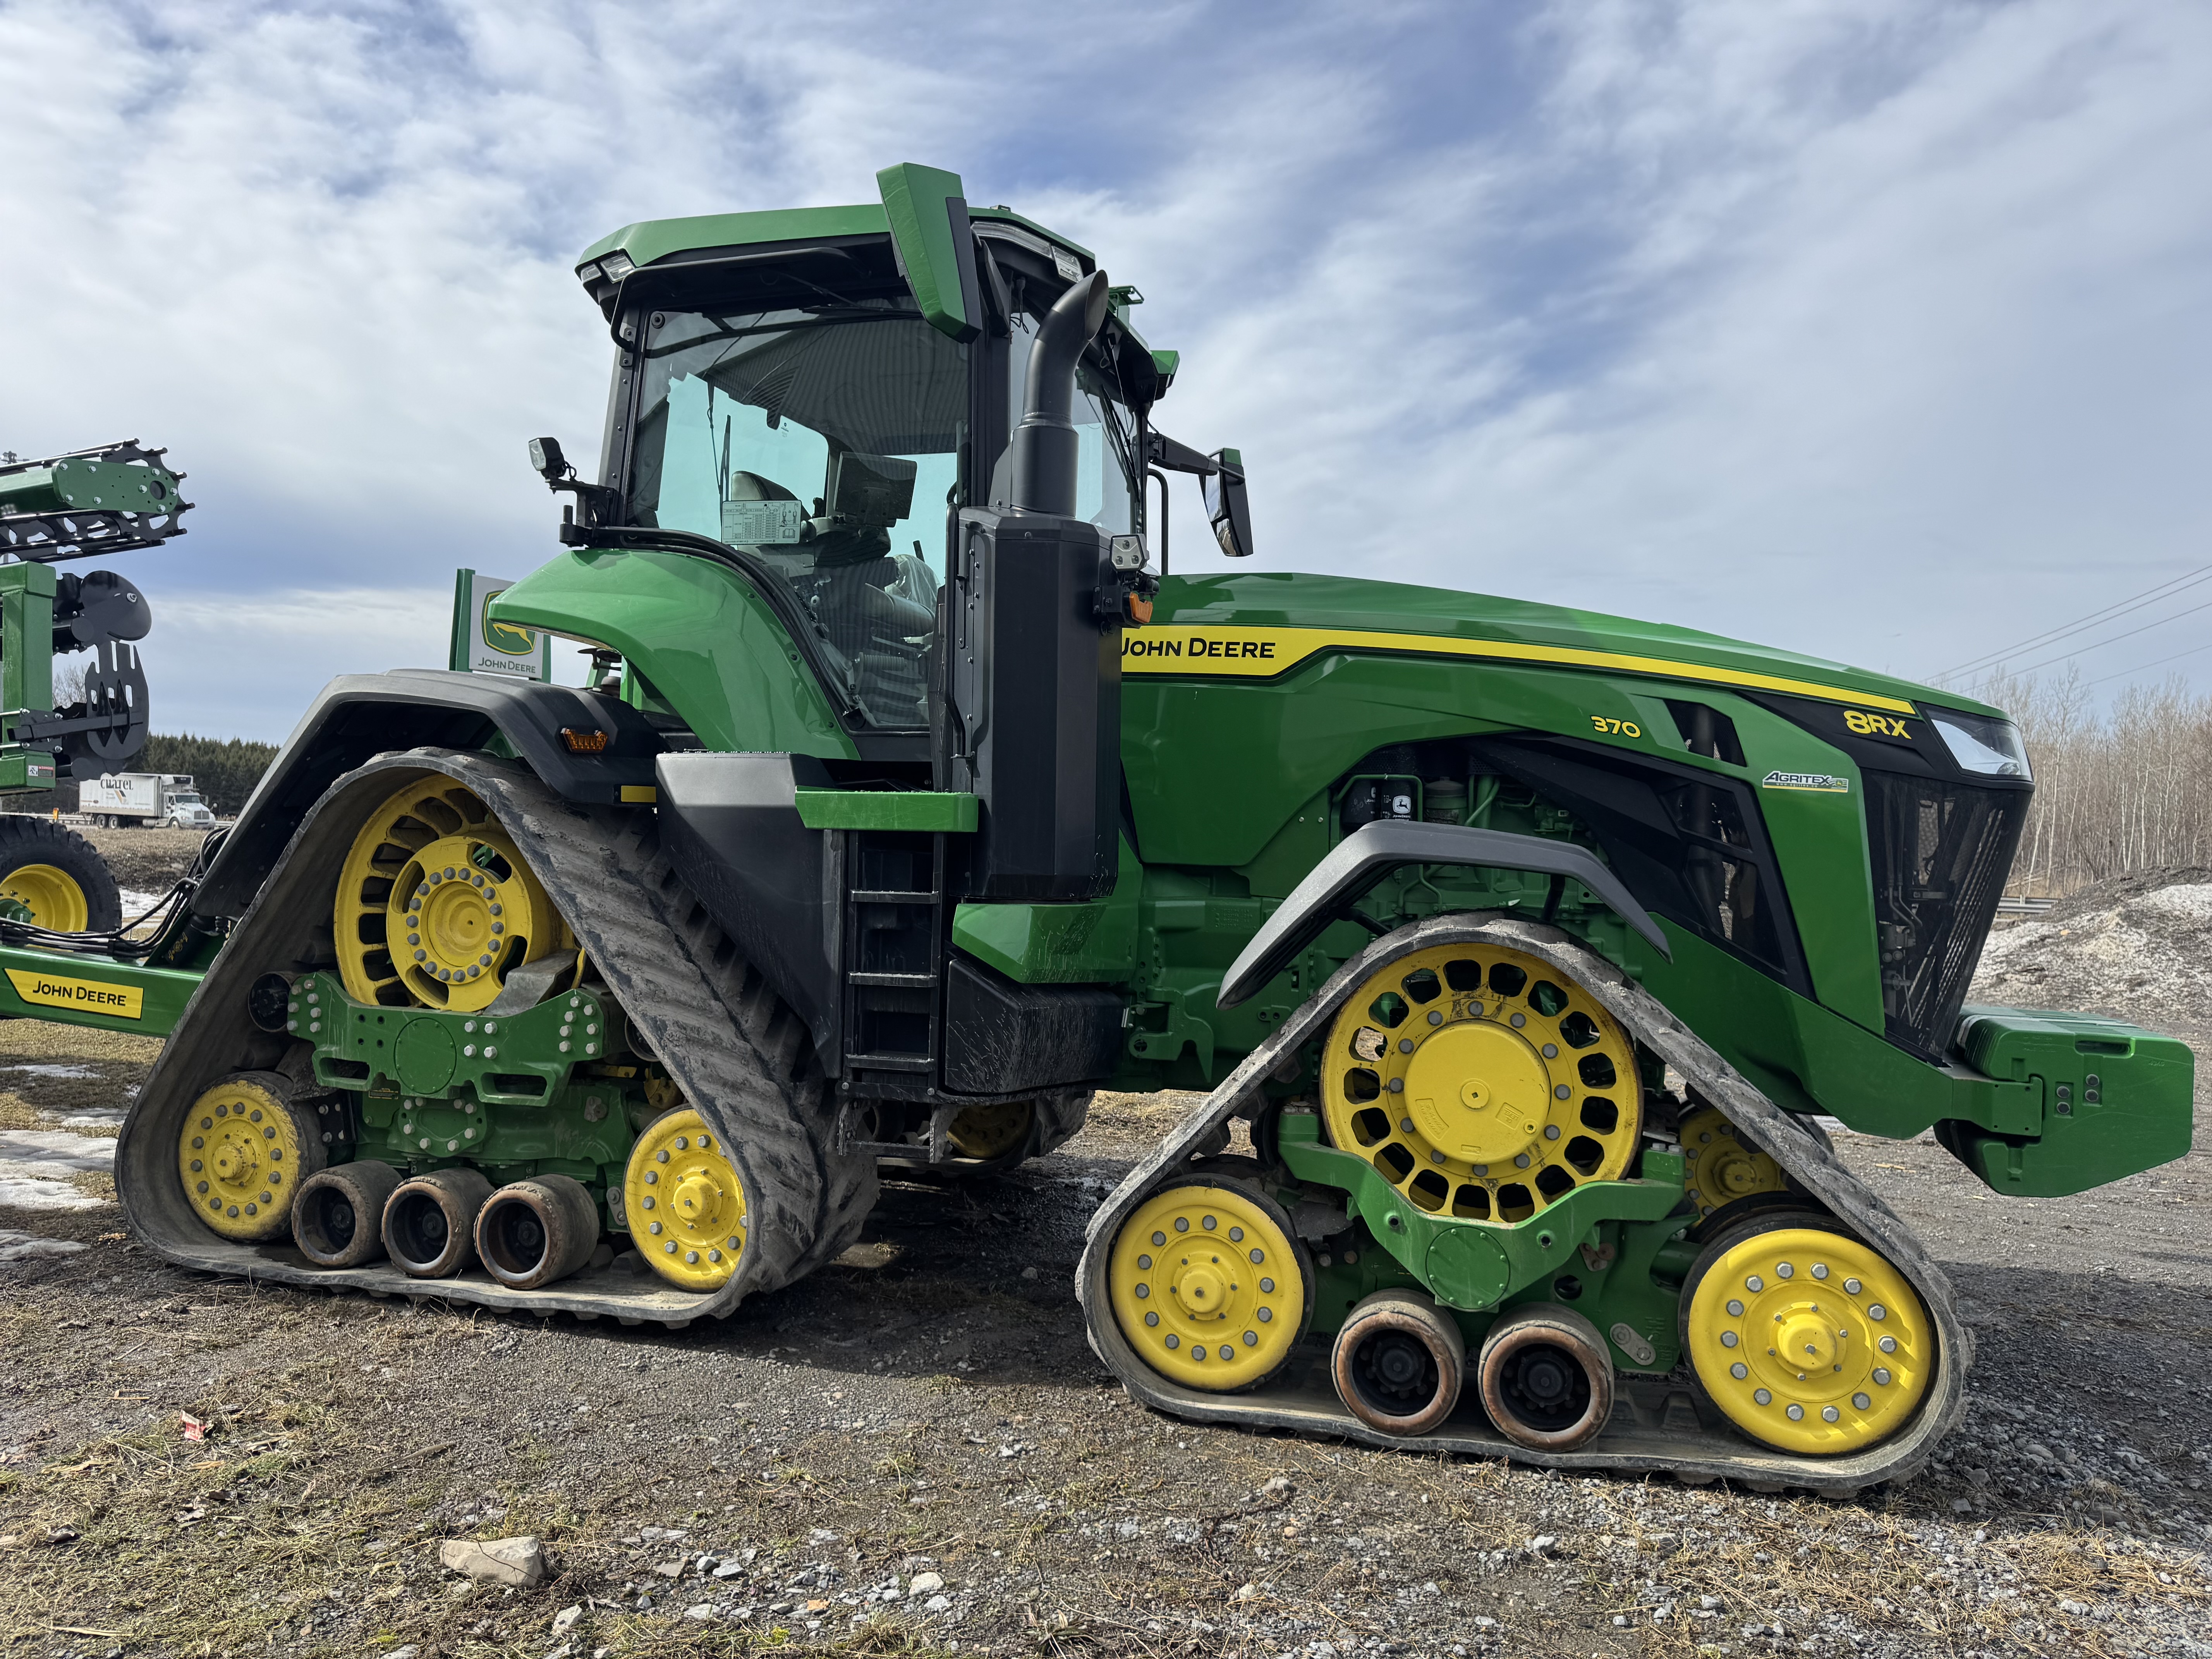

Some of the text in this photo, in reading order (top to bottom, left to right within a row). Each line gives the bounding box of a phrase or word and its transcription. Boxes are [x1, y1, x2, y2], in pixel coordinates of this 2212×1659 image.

[1122, 638, 1276, 658] JOHN DEERE
[478, 657, 536, 673] JOHN DEERE
[1590, 716, 1642, 738] 370
[1843, 710, 1912, 740] 8RX
[1765, 772, 1831, 786] AGRITEX
[33, 981, 127, 1006] JOHN DEERE
